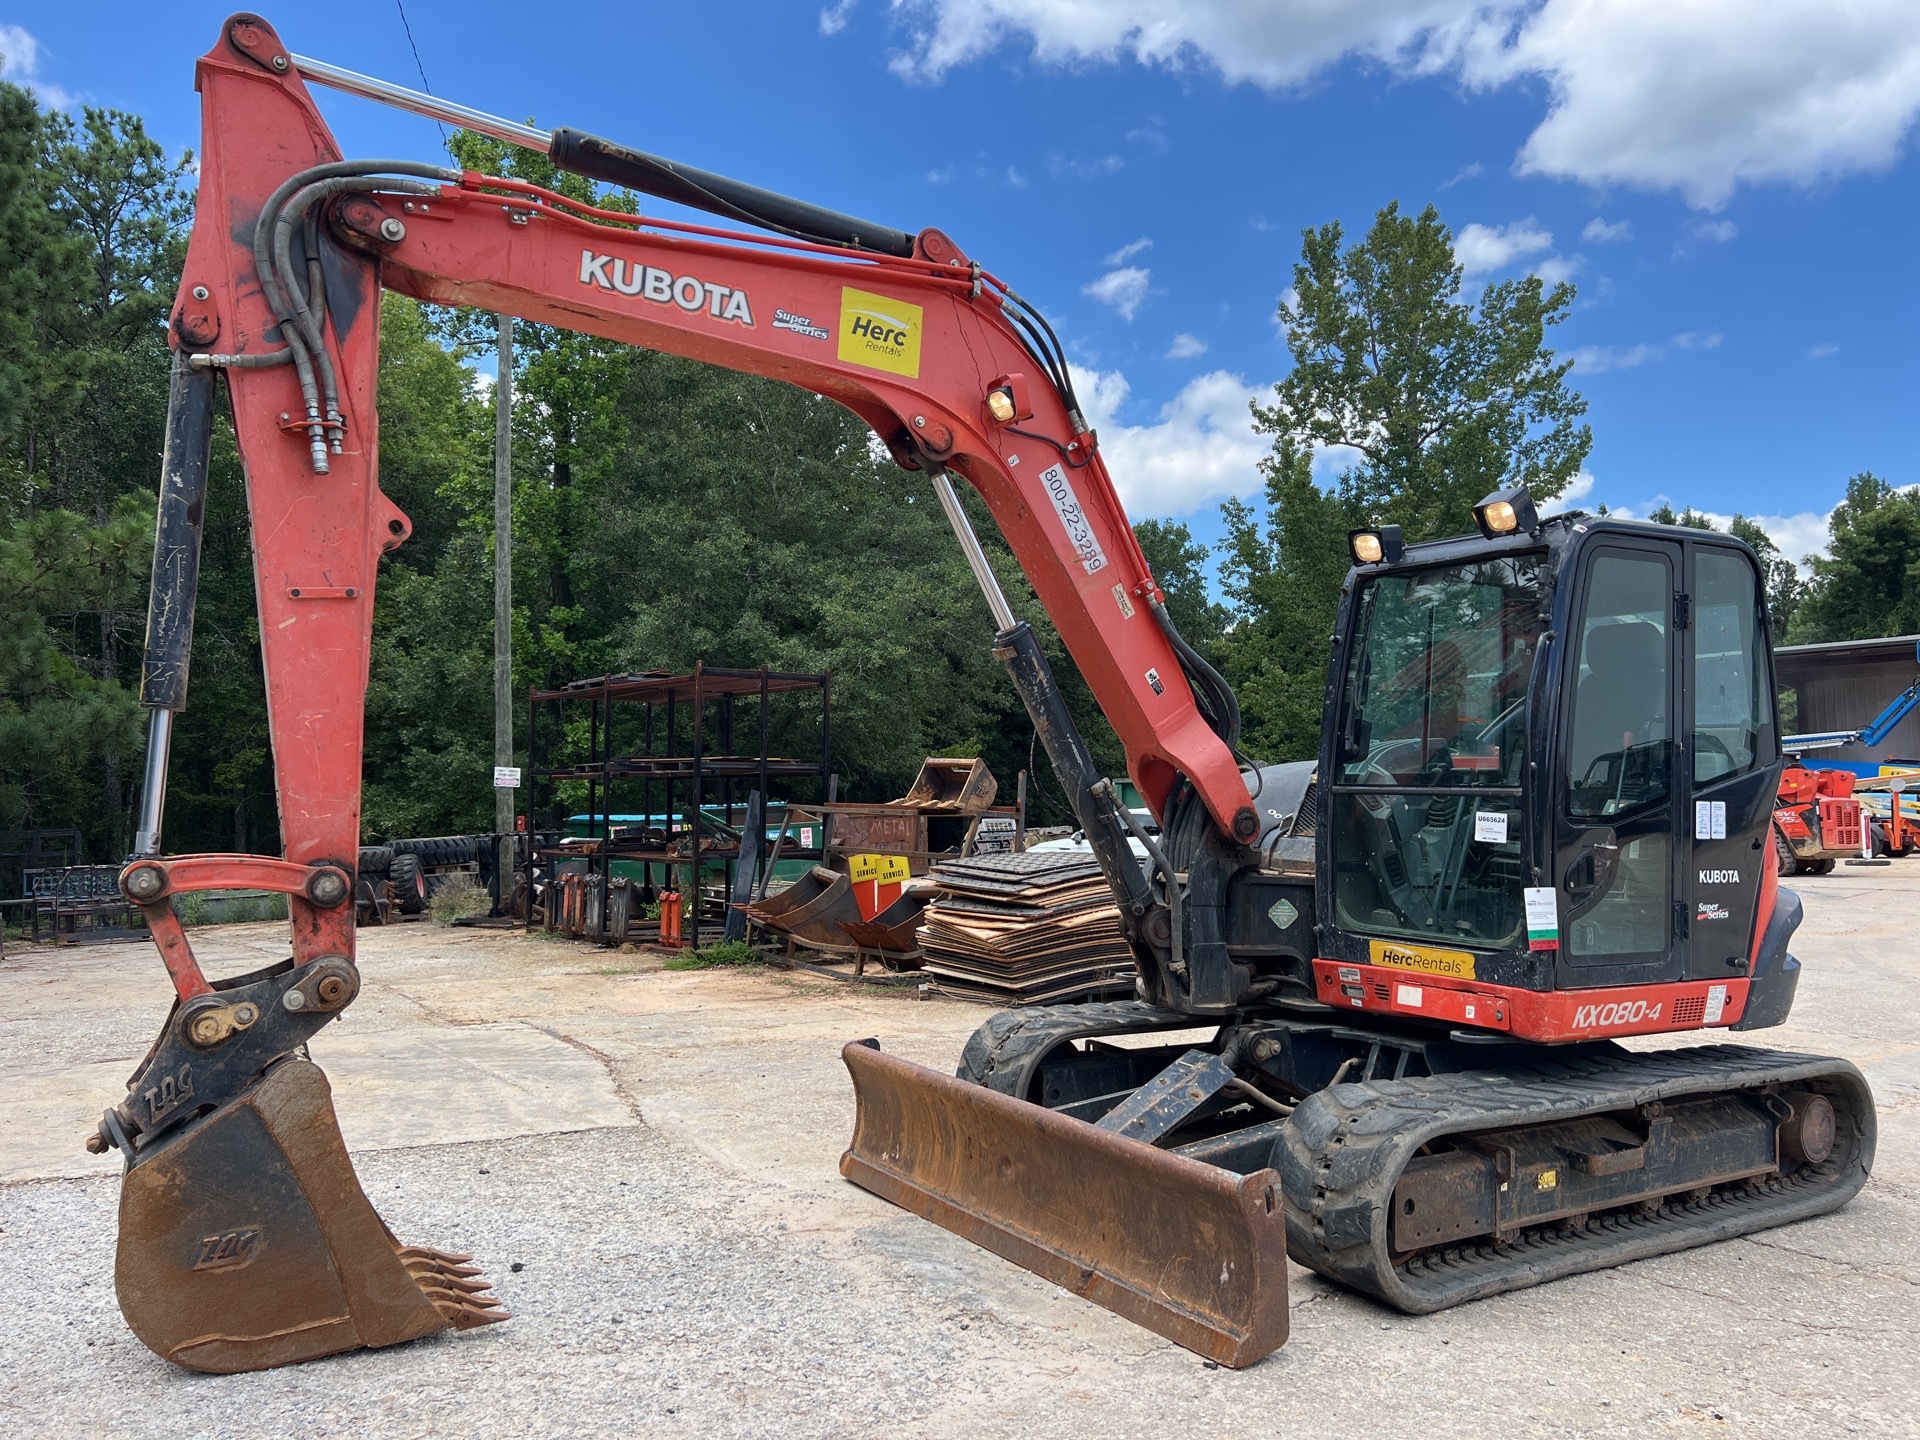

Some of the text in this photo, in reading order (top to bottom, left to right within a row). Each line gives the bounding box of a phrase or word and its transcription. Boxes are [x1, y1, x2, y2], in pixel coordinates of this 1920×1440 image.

[579, 249, 753, 325] KUBOTA
[774, 308, 811, 327] Super
[791, 322, 828, 340] Series
[851, 316, 908, 347] Herc
[865, 340, 902, 357] Rentals
[1045, 469, 1102, 571] 800-22-3289
[871, 819, 911, 836] METAL
[1478, 815, 1506, 823] U665624
[863, 857, 868, 866] A
[889, 859, 894, 868] B
[883, 869, 904, 880] SERVICE
[1699, 869, 1740, 883] KUBOTA
[1698, 902, 1719, 913] Super
[1708, 910, 1728, 919] Series
[1382, 950, 1462, 974] HercRentals
[1571, 1000, 1663, 1029] KX080-4
